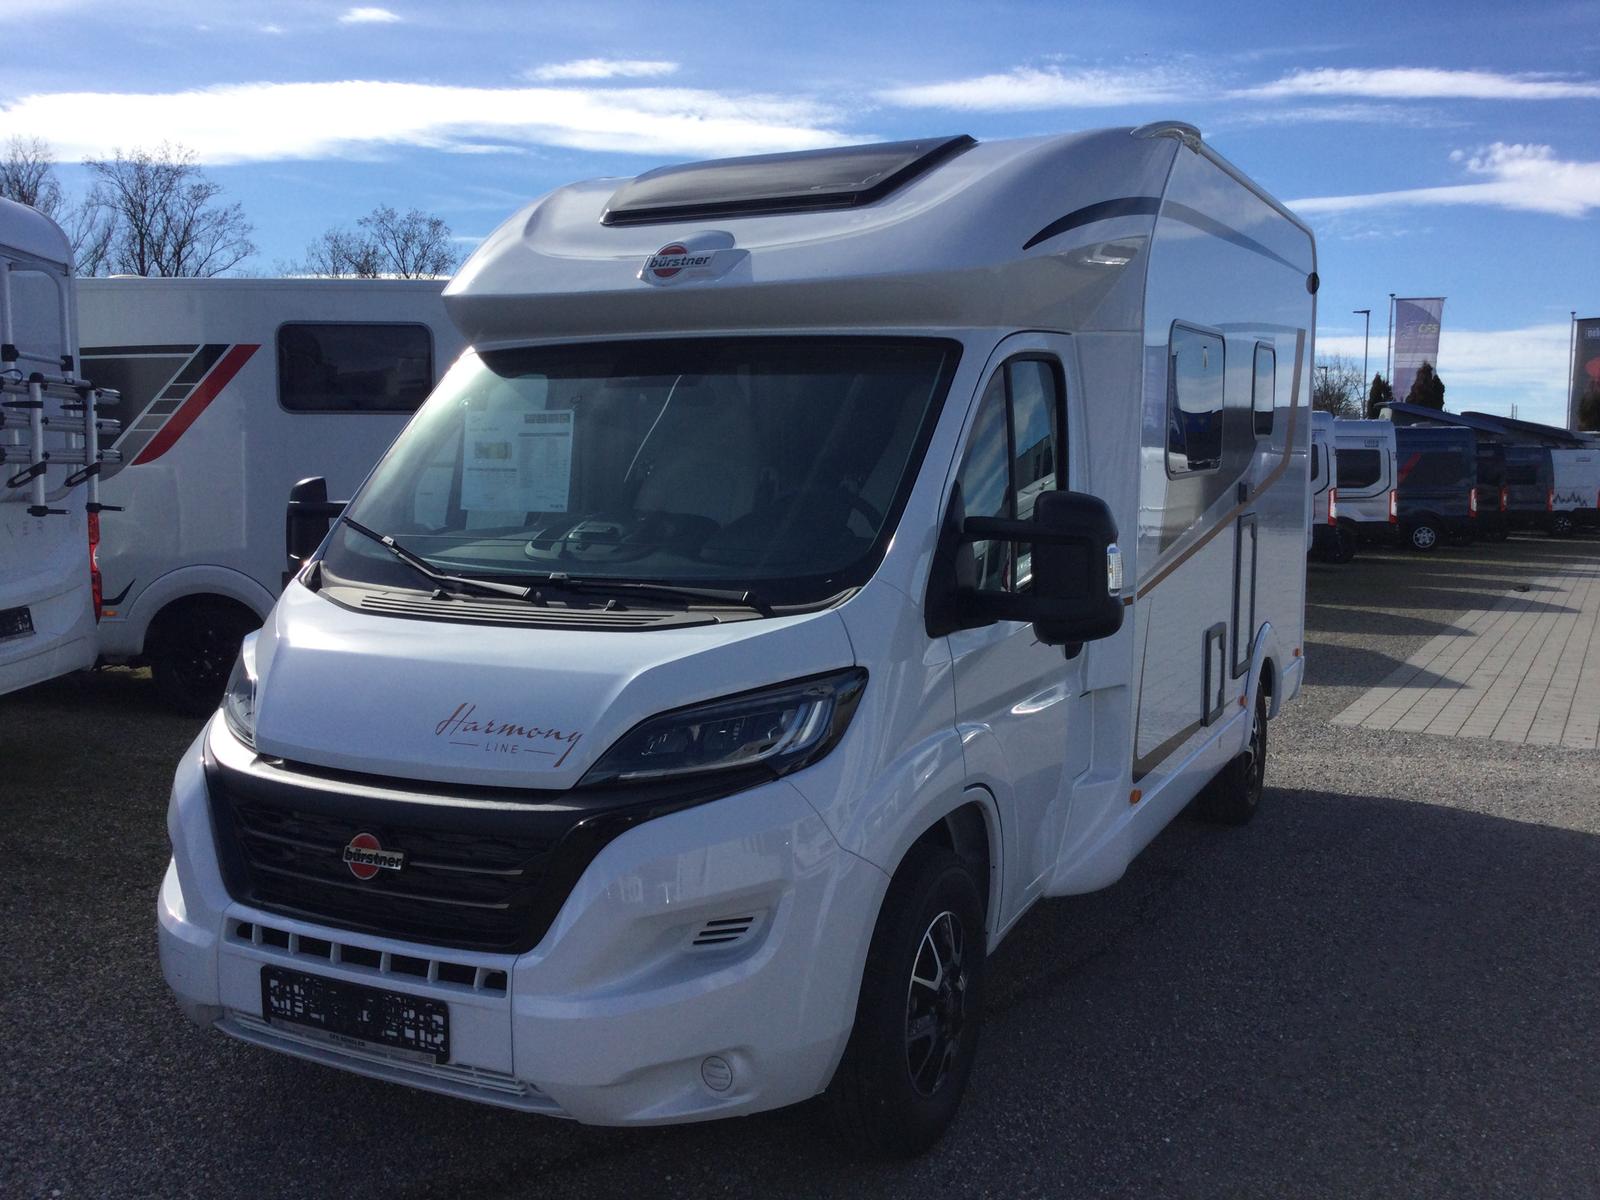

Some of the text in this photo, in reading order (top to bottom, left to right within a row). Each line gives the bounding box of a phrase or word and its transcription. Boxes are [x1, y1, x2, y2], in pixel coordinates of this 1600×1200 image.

[649, 256, 711, 268] bürstner
[435, 702, 584, 768] Harmony
[485, 741, 519, 753] LINE
[344, 847, 402, 868] bürstner
